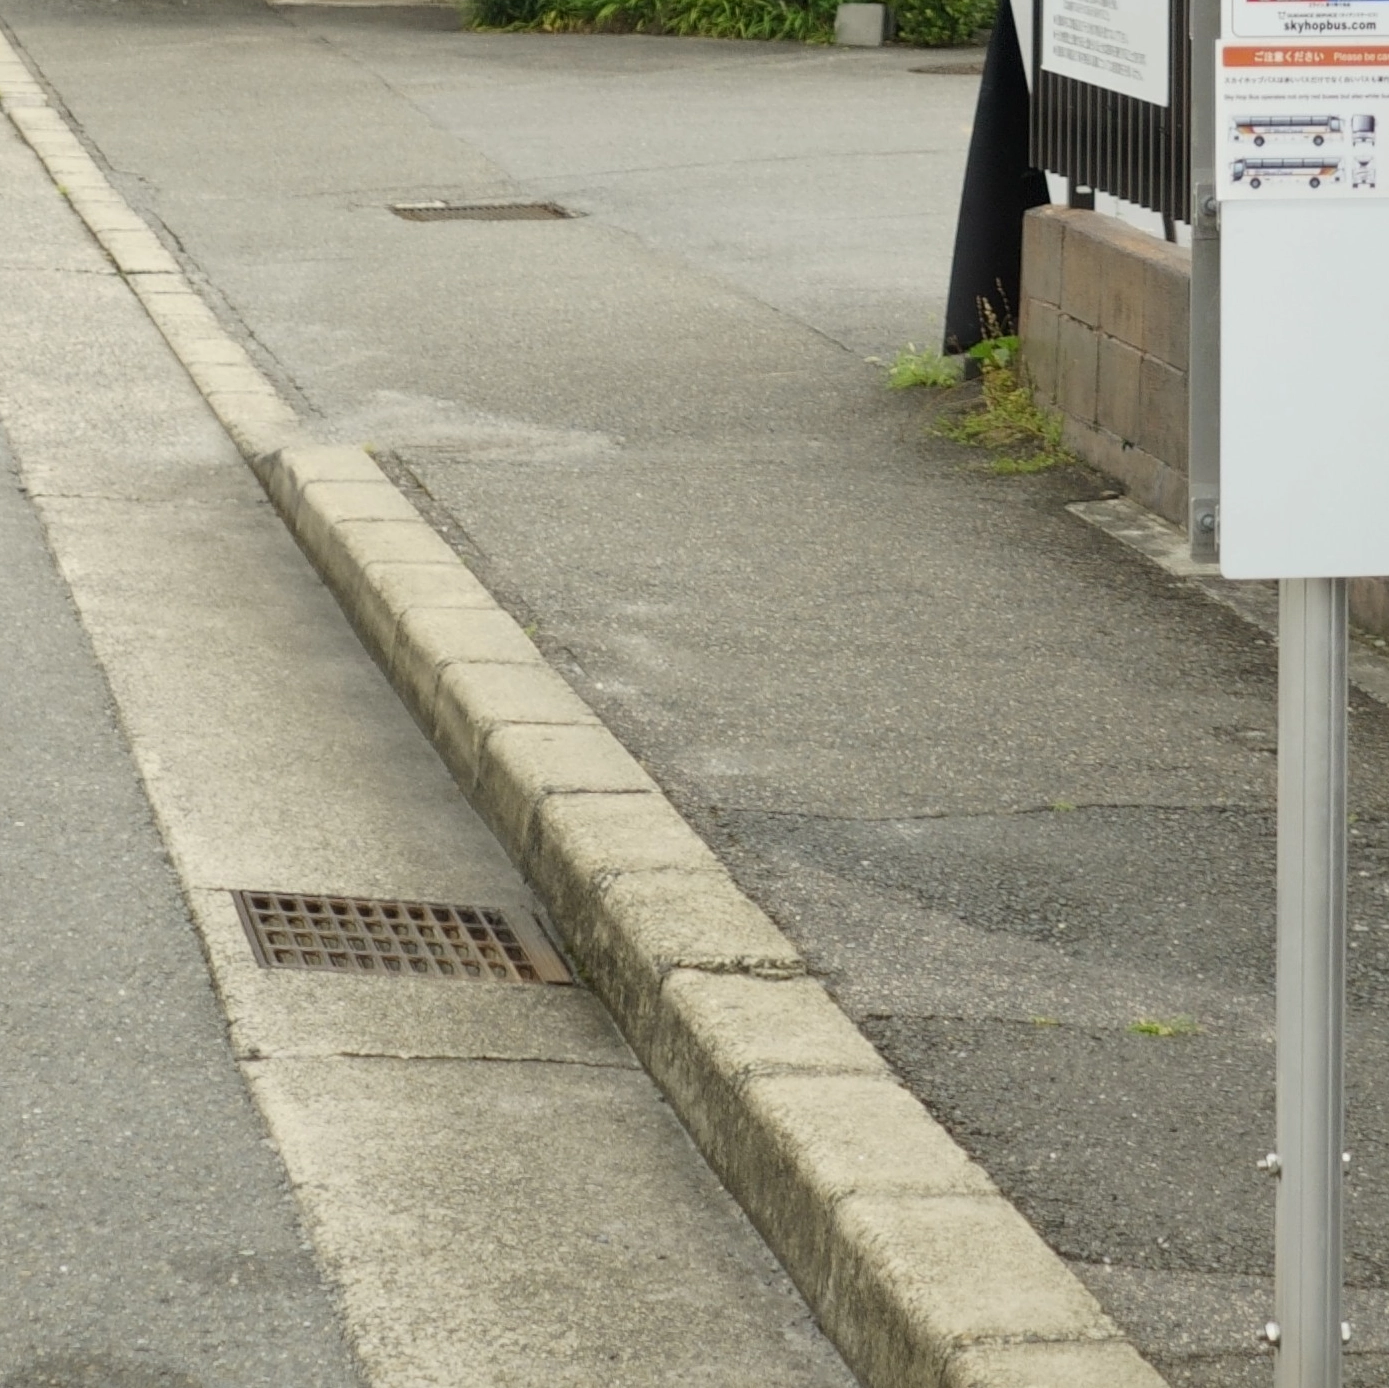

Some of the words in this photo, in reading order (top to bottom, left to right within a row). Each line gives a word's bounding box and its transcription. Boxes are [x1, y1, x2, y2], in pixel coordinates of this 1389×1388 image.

[1284, 20, 1376, 33] skyhopbus.com
[1254, 51, 1325, 62] ご注意ください
[1334, 52, 1363, 62] Please
[1364, 52, 1376, 61] be
